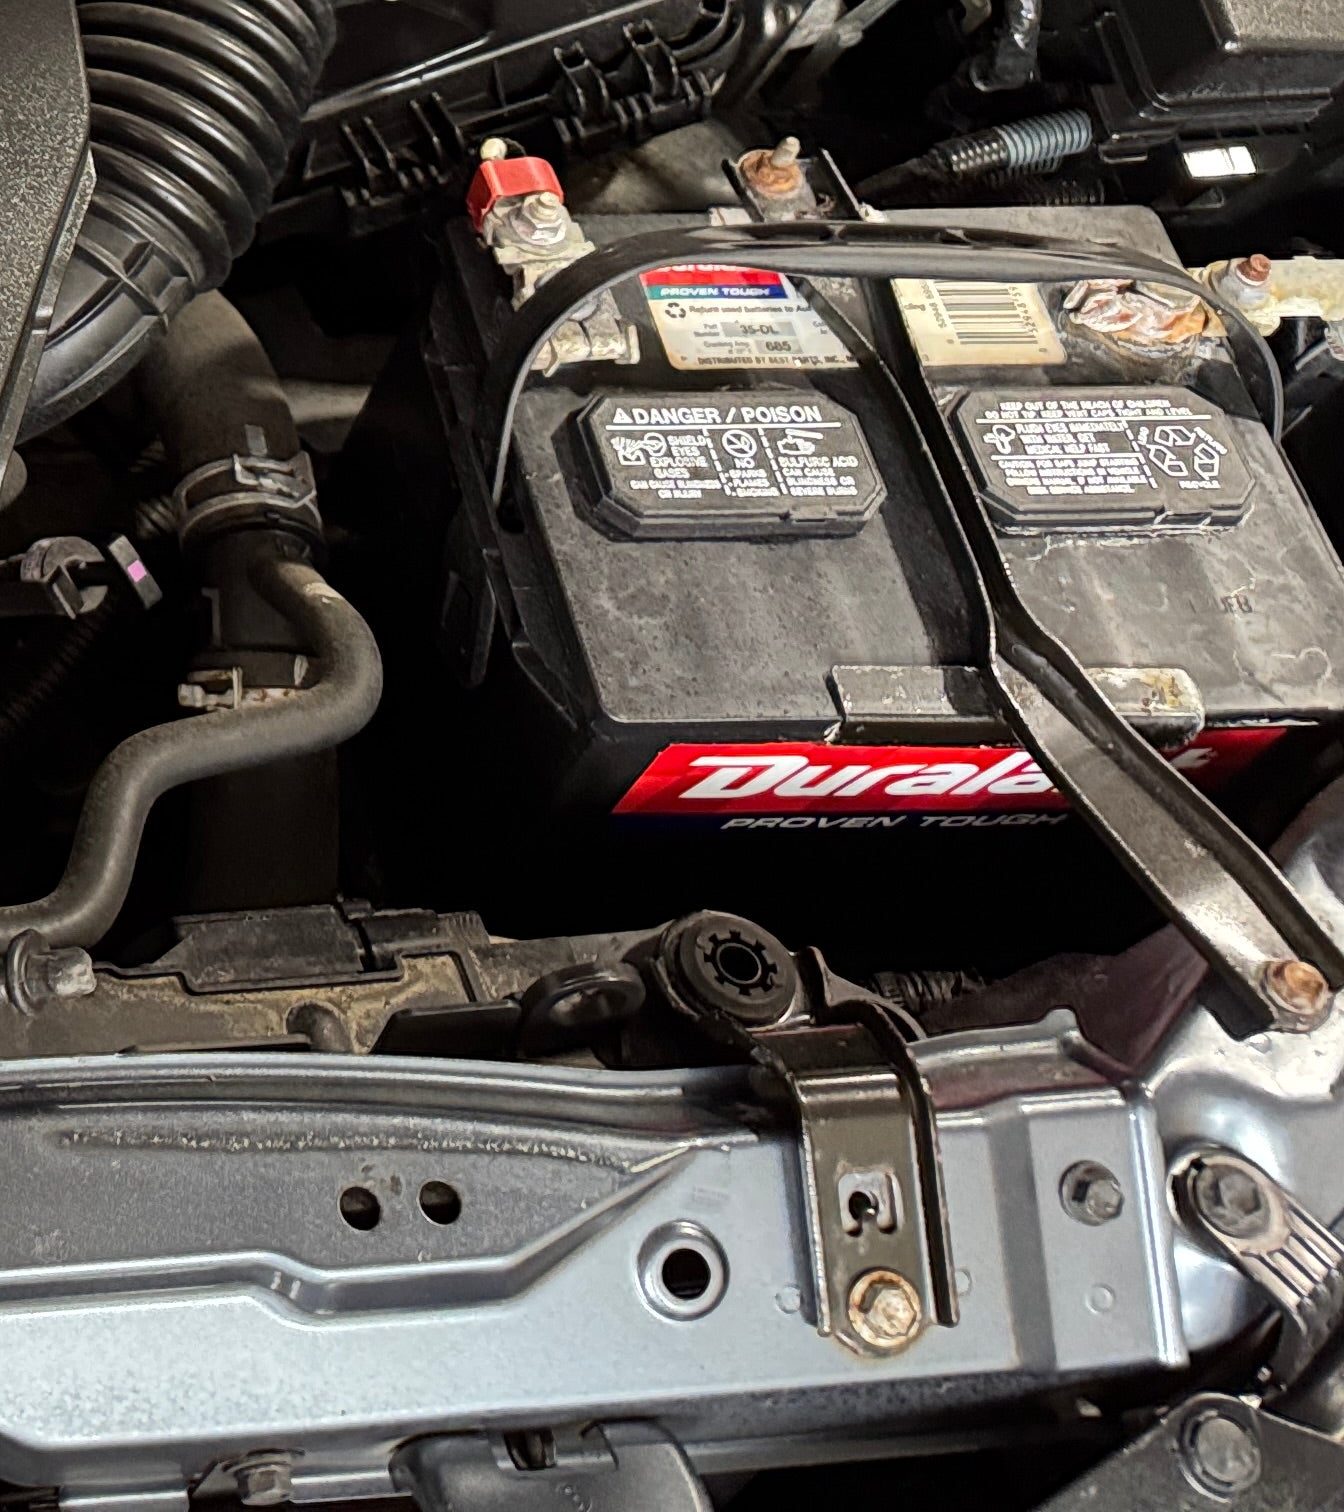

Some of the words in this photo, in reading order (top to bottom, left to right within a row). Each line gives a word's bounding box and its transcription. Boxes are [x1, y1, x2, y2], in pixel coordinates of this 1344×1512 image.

[660, 287, 719, 297] PROVEN
[721, 287, 771, 297] TOUGH
[739, 324, 779, 335] 35-DL
[765, 341, 792, 352] 685
[1024, 400, 1044, 410] OUT
[1045, 400, 1059, 410] OF
[1059, 400, 1080, 410] THE
[1112, 399, 1125, 409] OF
[631, 408, 721, 425] DANGER
[740, 405, 823, 422] POISON
[666, 434, 707, 446] SHIELD
[670, 446, 701, 457] EYES
[649, 455, 709, 468] EXPLOSIVE
[733, 457, 756, 469] NO
[777, 455, 830, 468] SULFURIC
[832, 455, 859, 467] ACID
[720, 814, 907, 830] PROVEN
[919, 813, 1069, 828] TOUGH
